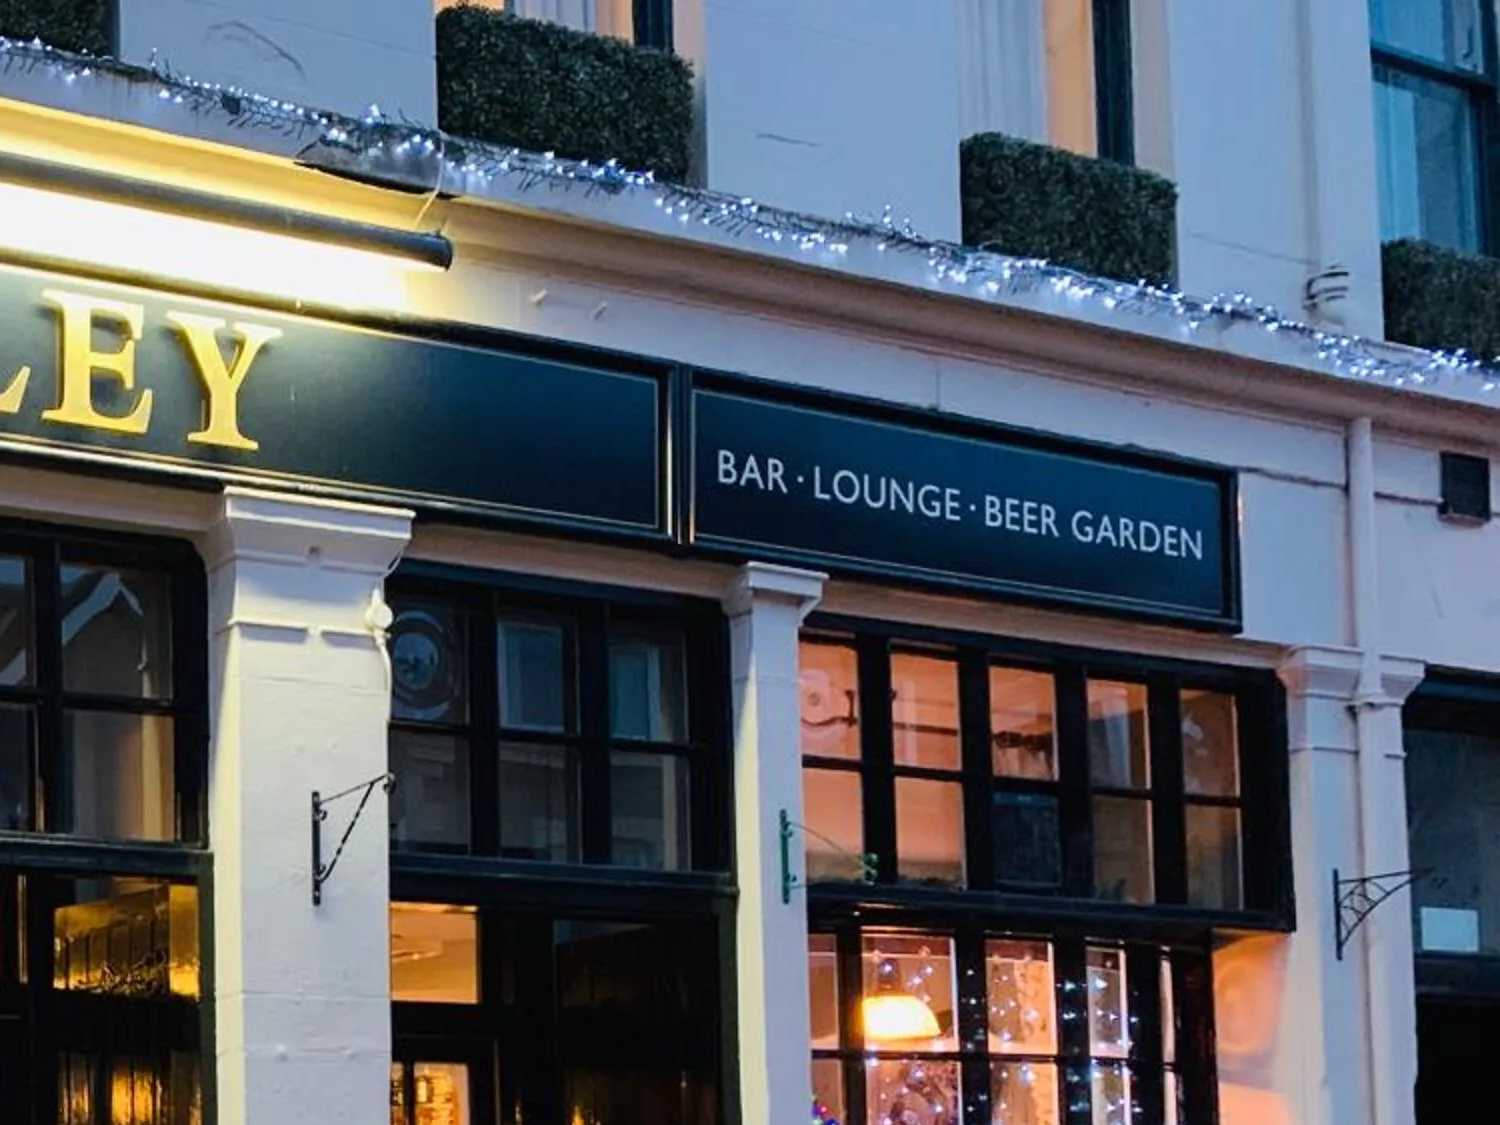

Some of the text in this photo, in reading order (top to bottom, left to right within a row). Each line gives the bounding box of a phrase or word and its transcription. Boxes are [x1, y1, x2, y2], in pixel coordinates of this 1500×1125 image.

[717, 449, 1203, 560] BAR LOUNGE BEER GARDEN
